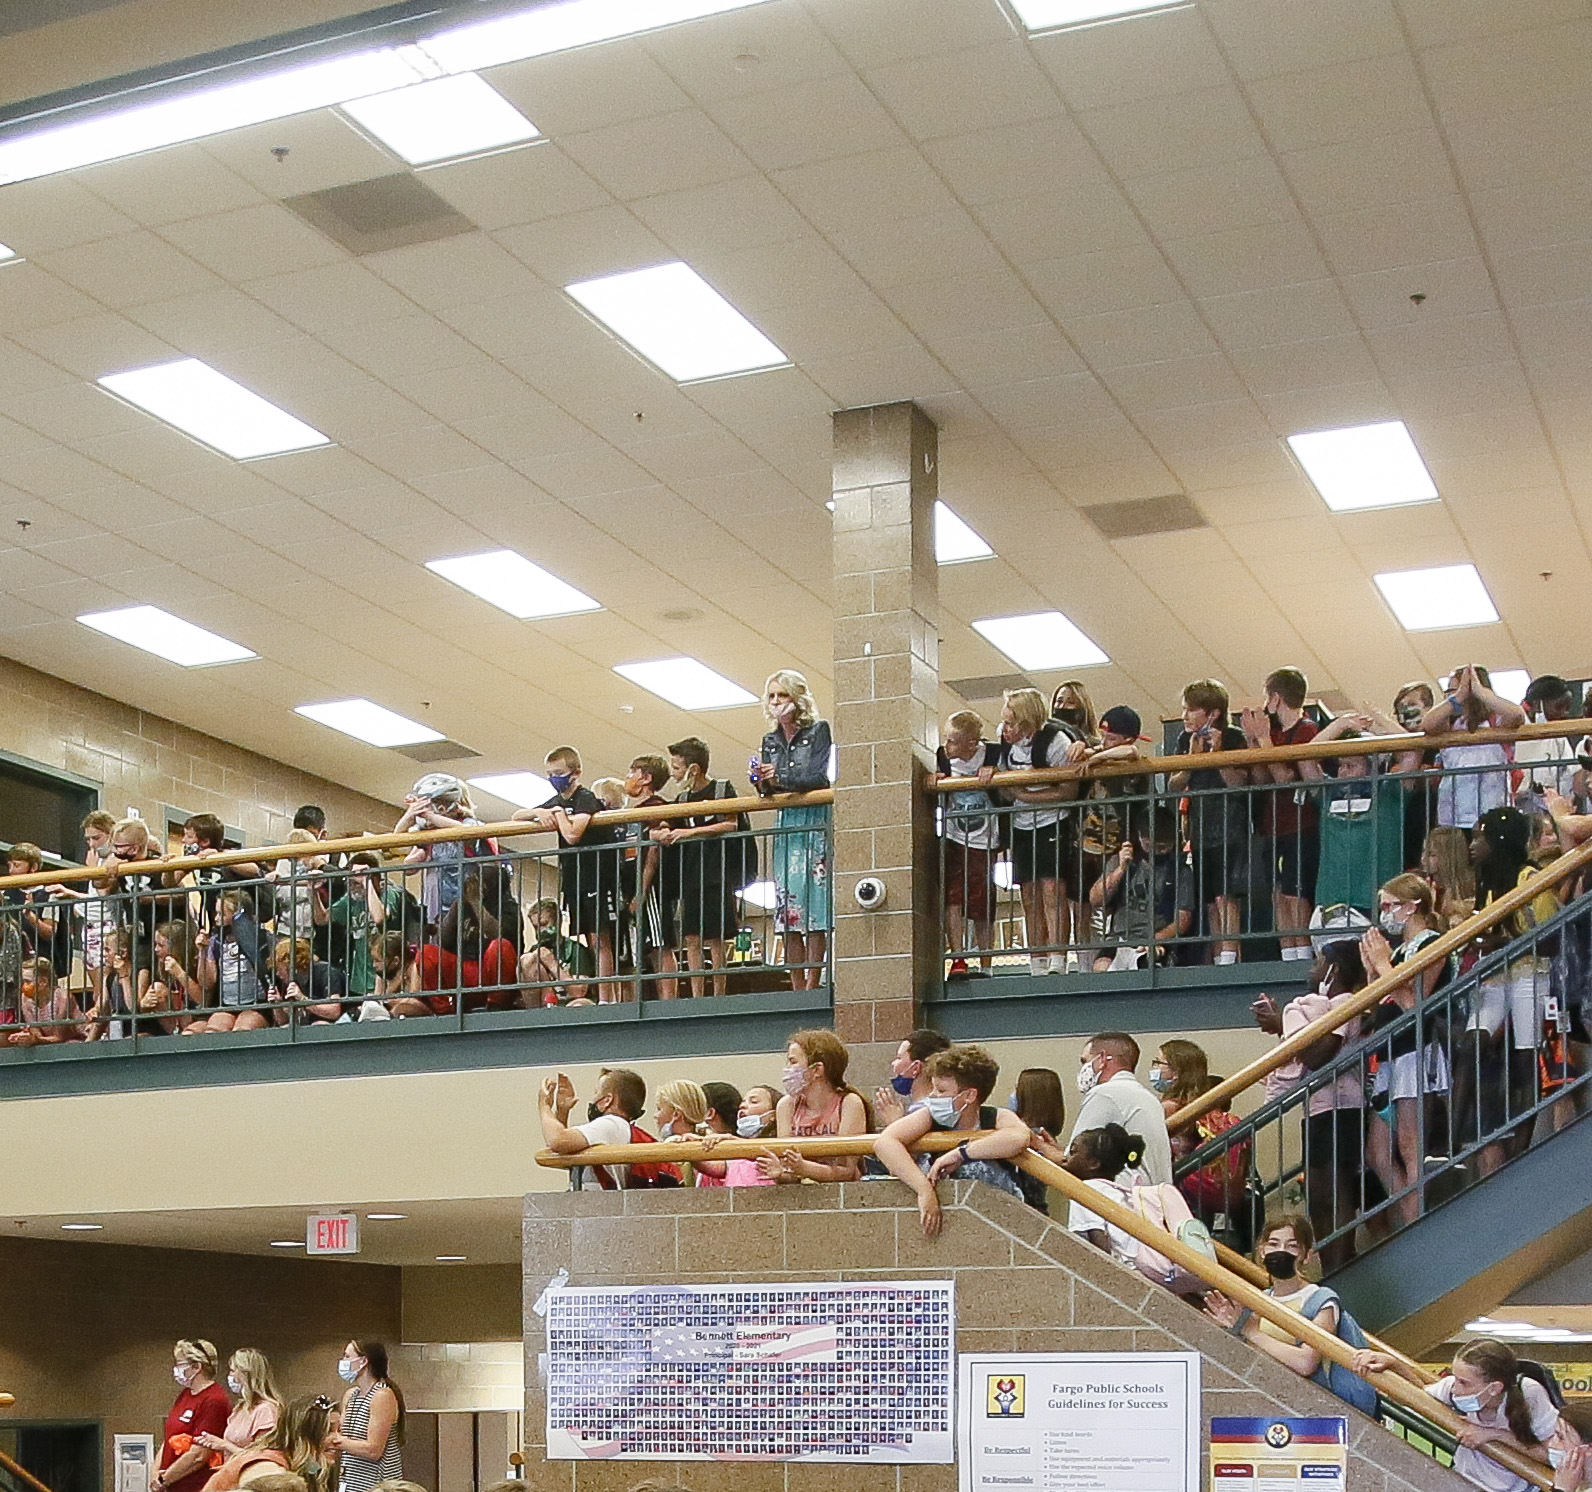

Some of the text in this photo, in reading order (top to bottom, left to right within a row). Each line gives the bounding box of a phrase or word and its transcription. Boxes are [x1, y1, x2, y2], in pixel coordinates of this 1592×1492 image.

[317, 1219, 350, 1249] EXIT
[695, 1331, 792, 1342] Bennett Elementary
[1052, 1383, 1165, 1396] Fargo Public Schools
[1048, 1398, 1169, 1409] Guidelines for Success
